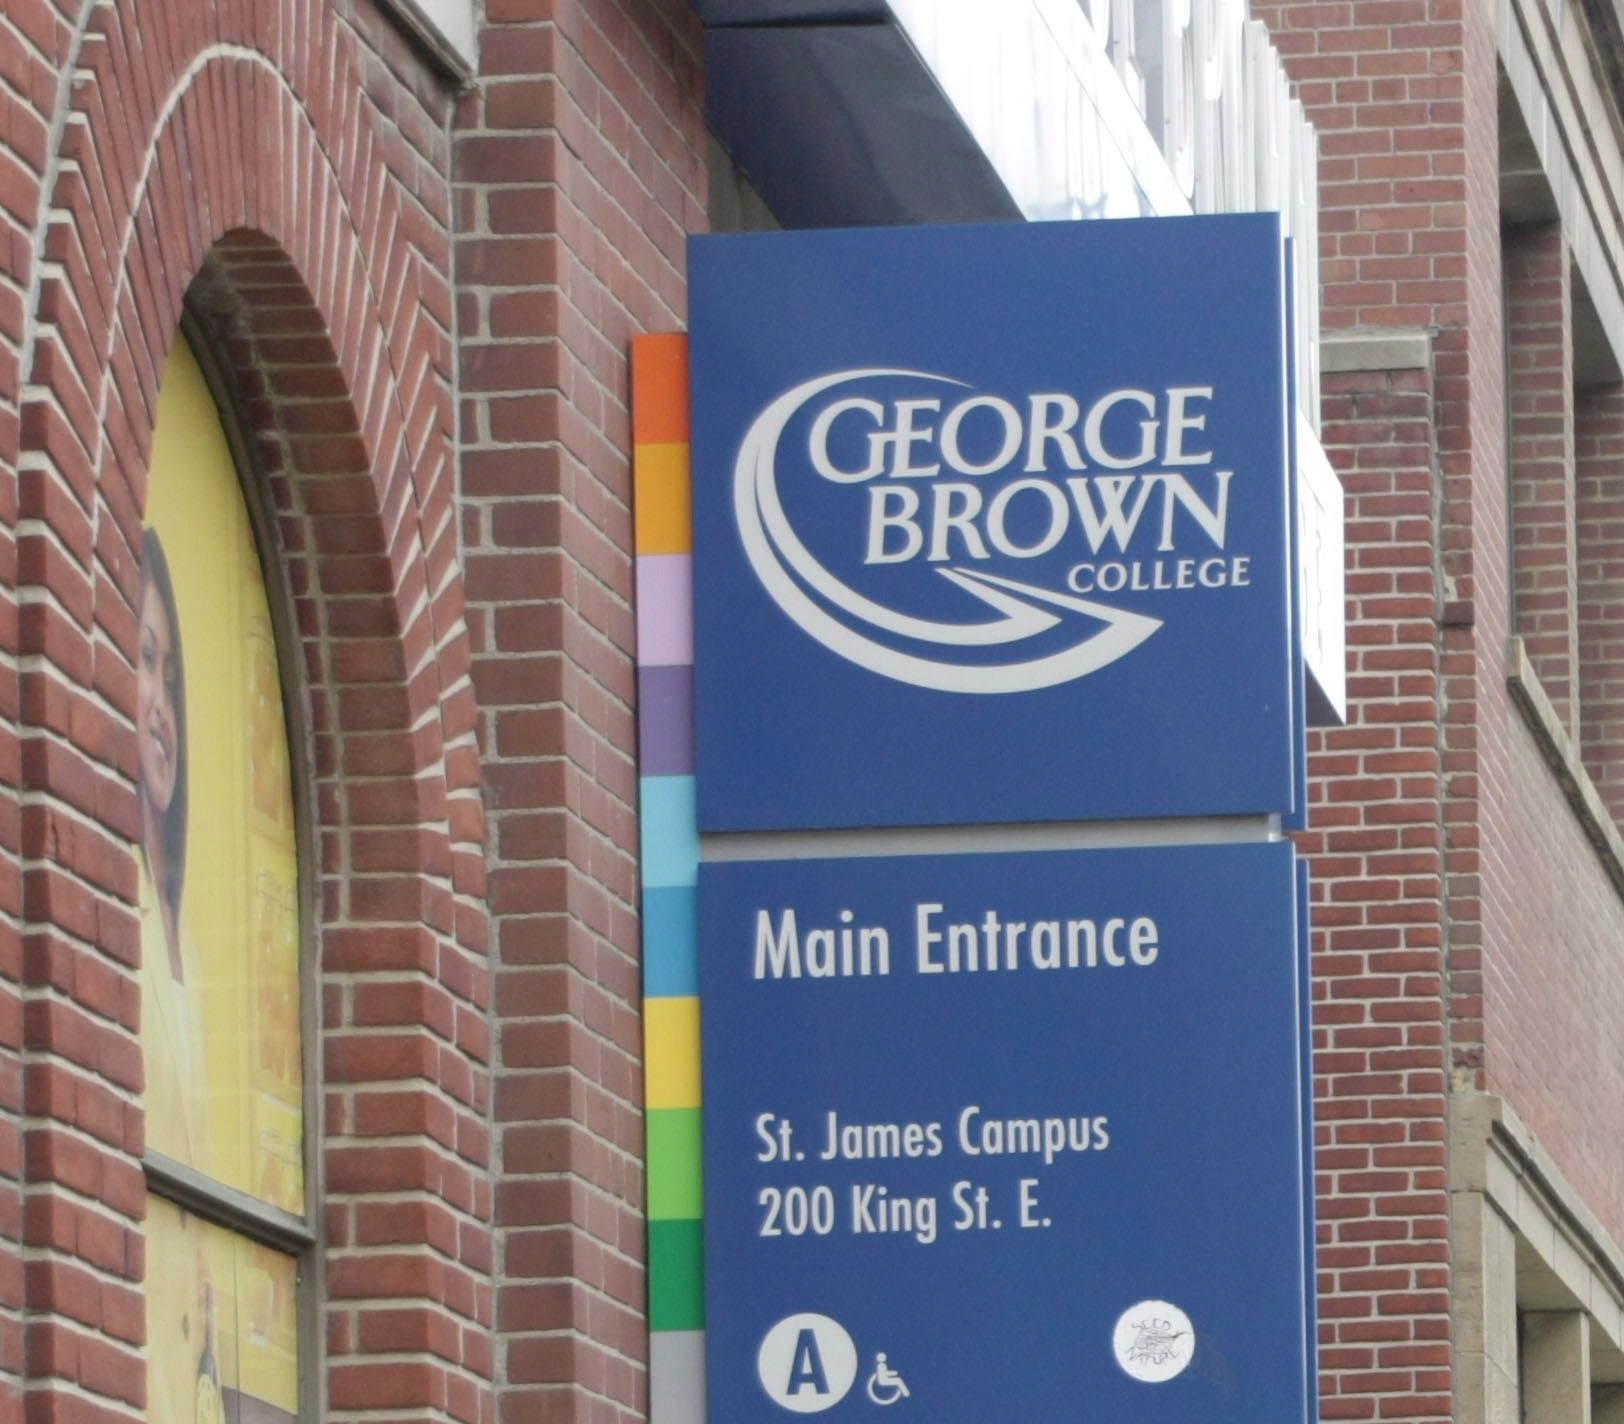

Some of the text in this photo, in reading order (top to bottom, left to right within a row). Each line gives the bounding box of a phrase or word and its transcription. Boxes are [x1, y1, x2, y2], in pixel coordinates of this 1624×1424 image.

[809, 386, 1214, 484] GEORGE
[863, 470, 1234, 566] BROWN
[1067, 556, 1251, 595] COLLEGE
[753, 903, 1160, 981] Main Entrance
[754, 1105, 1111, 1165] St. James Campus
[757, 1178, 1052, 1245] 200 King St. E.
[786, 1327, 831, 1396] A
